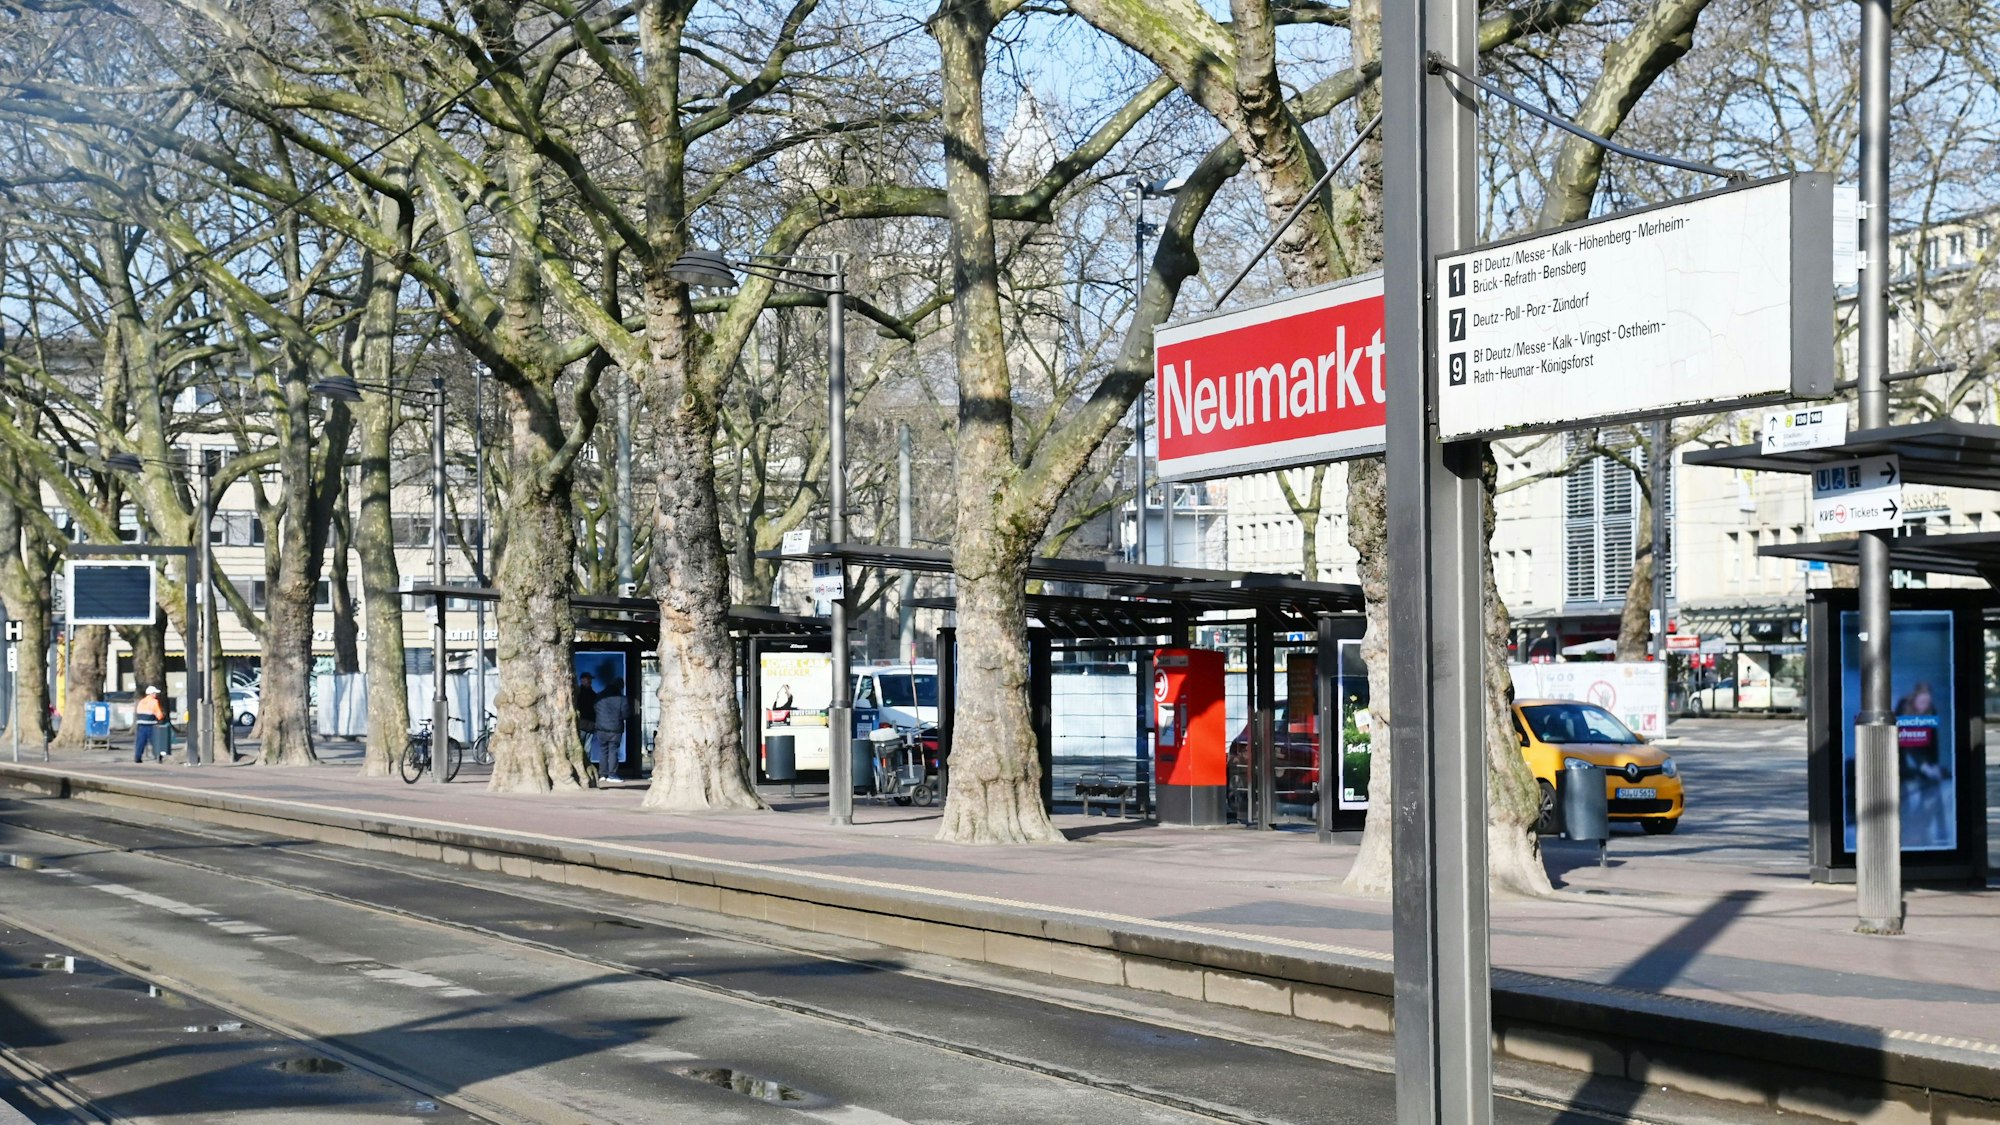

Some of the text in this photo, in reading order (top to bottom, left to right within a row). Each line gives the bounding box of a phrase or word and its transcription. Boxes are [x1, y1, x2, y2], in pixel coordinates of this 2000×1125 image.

[1473, 260, 1483, 274] Bf
[1473, 349, 1484, 364] Bf
[1163, 325, 1385, 439] Neumarkt
[1818, 471, 1829, 490] U
[1820, 507, 1879, 521] KVB Tickets
